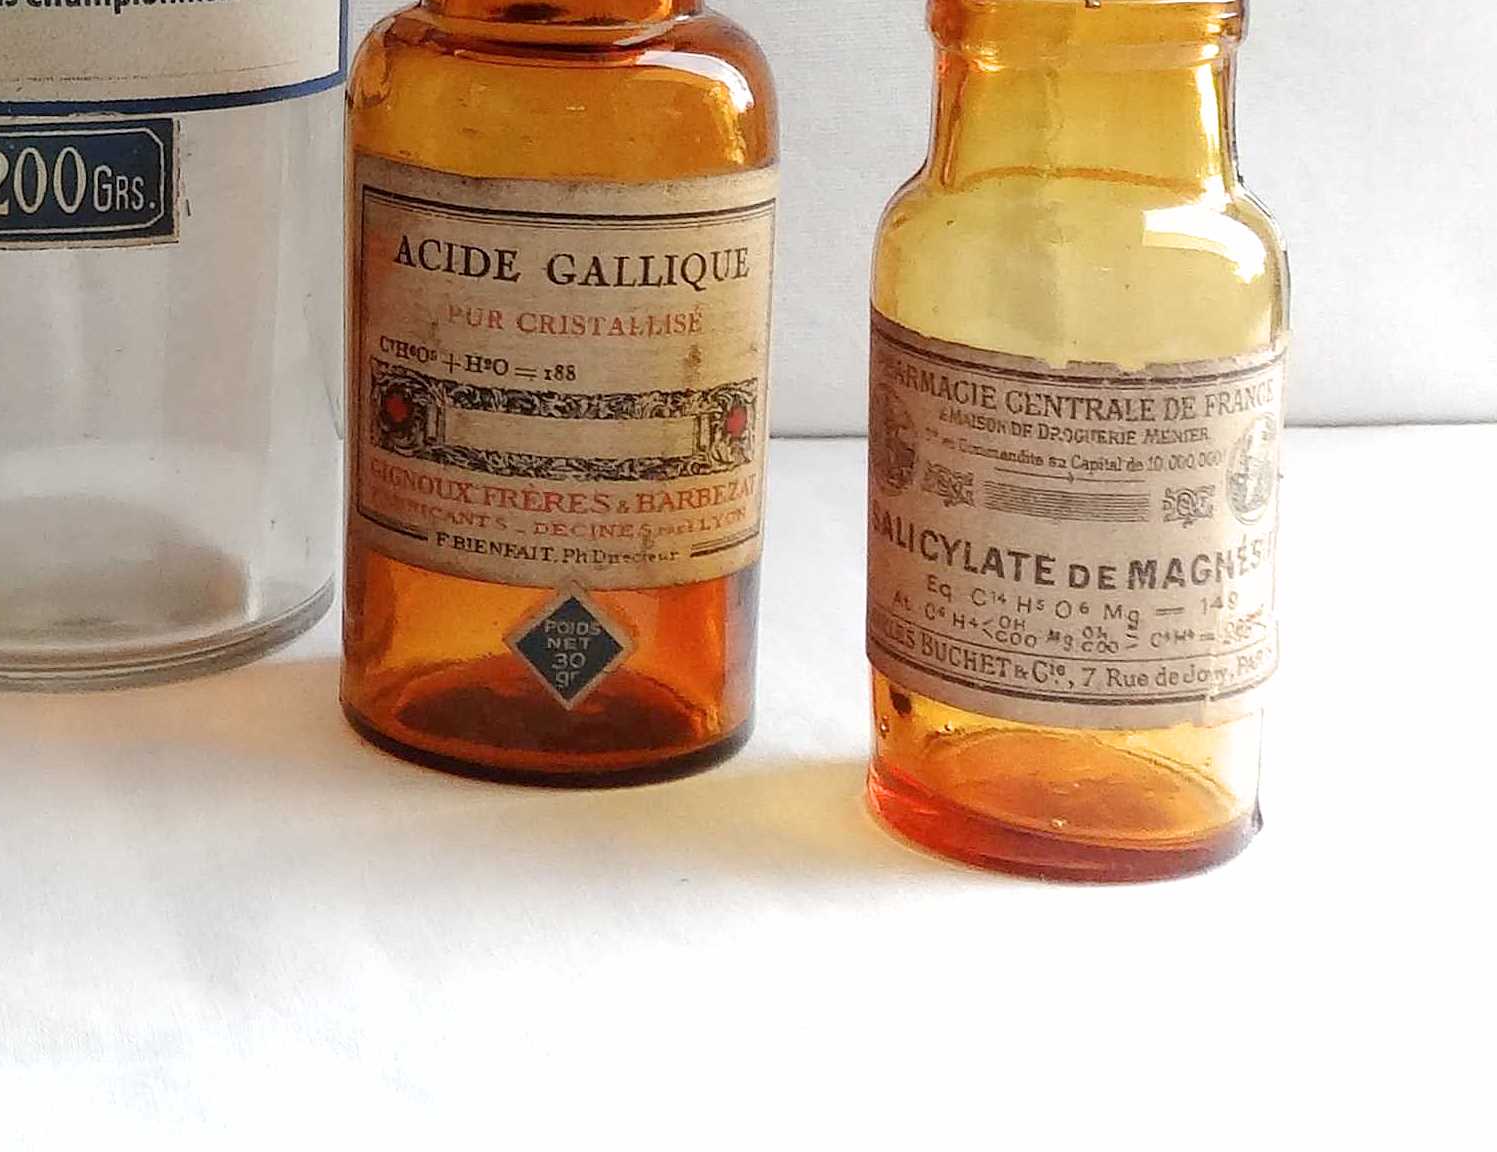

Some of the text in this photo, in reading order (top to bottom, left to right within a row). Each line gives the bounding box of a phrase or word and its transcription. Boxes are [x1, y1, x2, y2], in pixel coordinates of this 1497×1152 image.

[393, 235, 750, 292] ACIDE GALLIQUE
[448, 305, 503, 331] PUR
[1006, 390, 1156, 422] CENTRALE
[1163, 396, 1197, 422] DE
[1205, 378, 1274, 417] FRANCE
[370, 457, 756, 515] GIGNOUX FRÈRES & BARBEZAT
[1069, 564, 1117, 590] DE
[545, 619, 602, 636] POIDS
[547, 637, 591, 651] NET
[552, 652, 586, 670] 30
[921, 629, 1012, 677] BUCHET
[1081, 667, 1096, 687] 7
[1106, 667, 1149, 688] Rue
[1155, 666, 1179, 687] de
